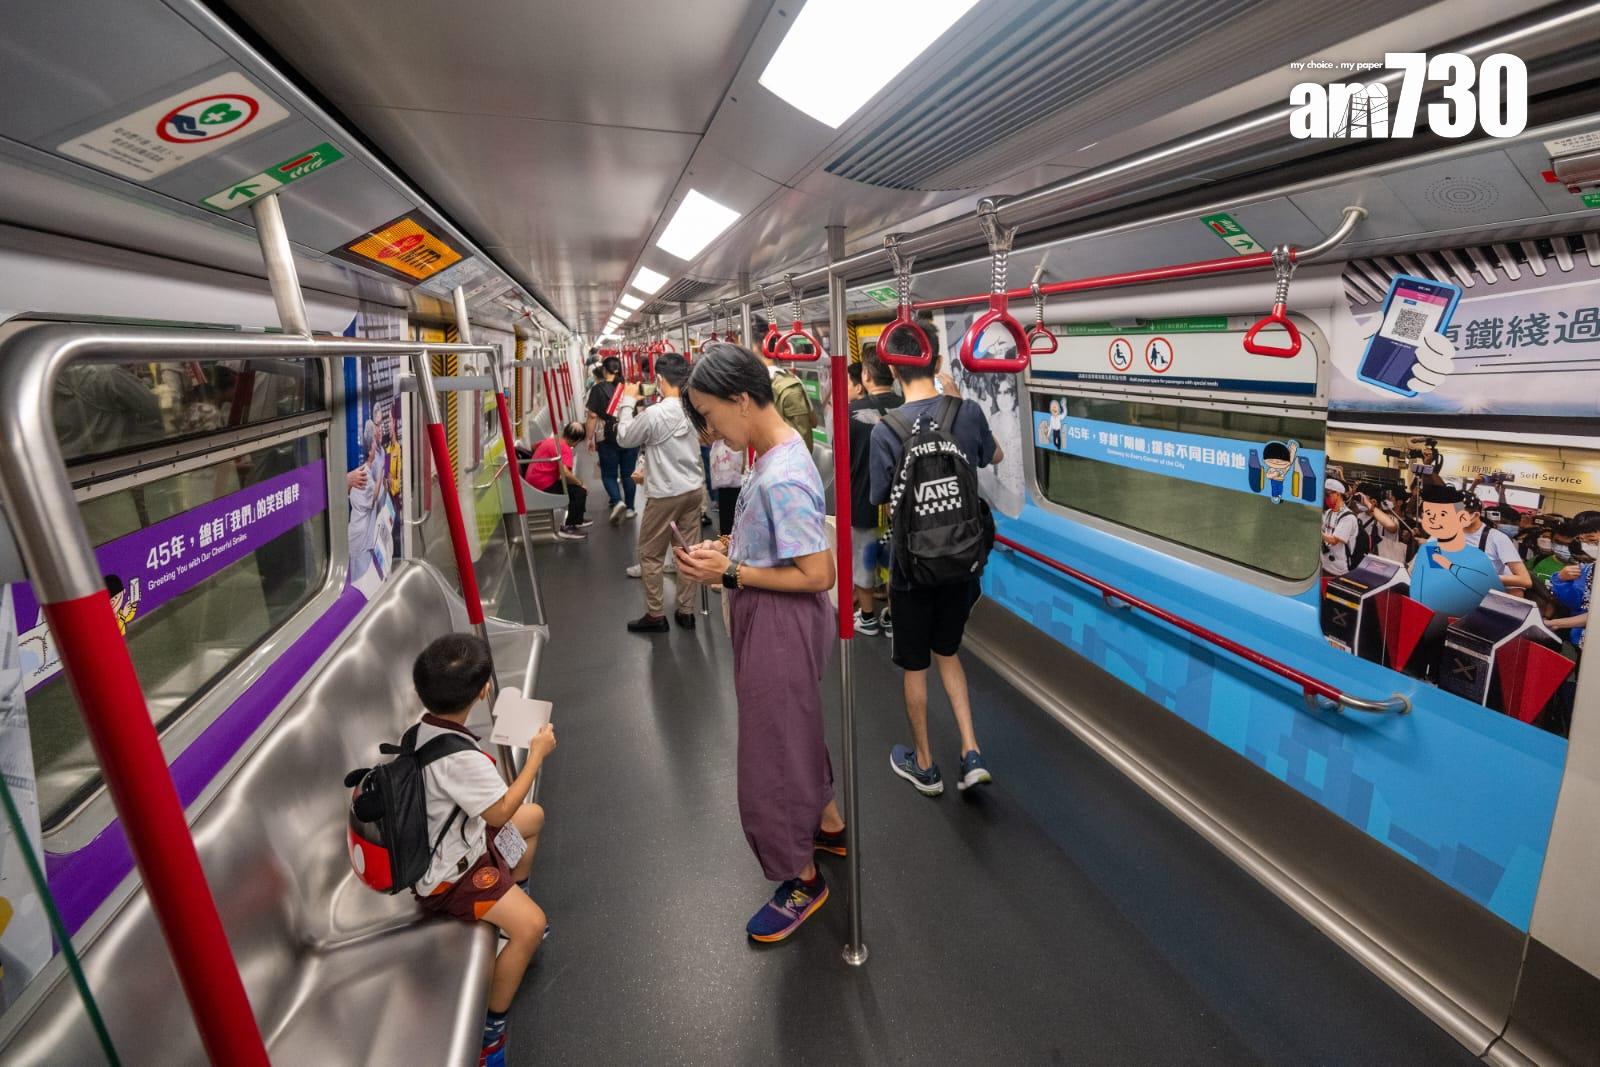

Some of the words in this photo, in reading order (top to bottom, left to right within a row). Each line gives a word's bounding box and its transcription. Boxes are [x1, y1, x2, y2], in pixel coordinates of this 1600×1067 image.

[911, 442, 937, 456] THE
[1520, 471, 1539, 479] Self
[1542, 473, 1582, 485] Service
[913, 475, 959, 503] VANS
[148, 571, 176, 590] Greeting
[176, 565, 188, 575] You
[188, 557, 201, 569] with
[201, 551, 211, 562] Our
[211, 540, 232, 556] Cheerful
